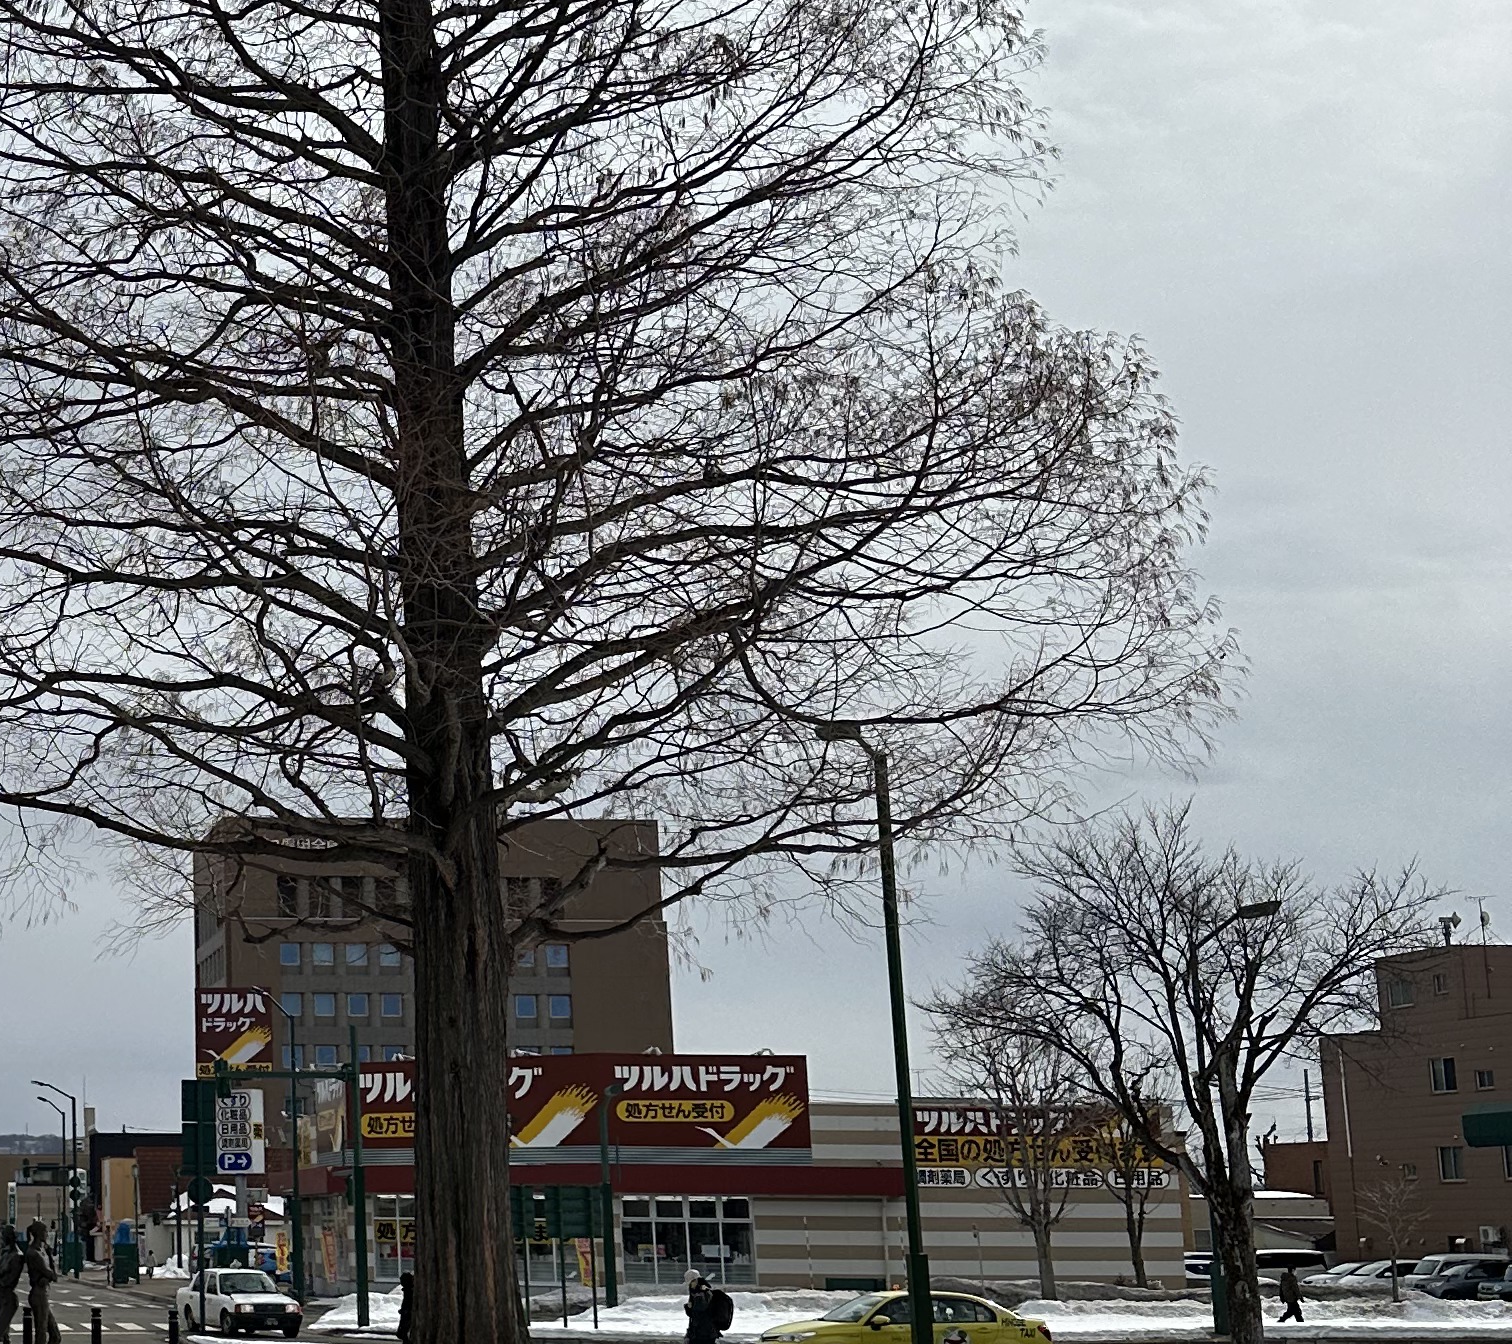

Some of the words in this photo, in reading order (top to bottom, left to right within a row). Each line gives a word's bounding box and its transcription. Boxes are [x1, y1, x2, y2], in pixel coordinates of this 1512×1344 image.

[201, 993, 266, 1014] ツルハ
[201, 1017, 256, 1032] ドラッグ
[614, 1065, 795, 1092] ツルハドラッグ
[221, 1109, 247, 1121] 化粧品
[625, 1102, 725, 1119] 処方せん受付
[221, 1123, 247, 1134] 日用品
[224, 1154, 236, 1169] P
